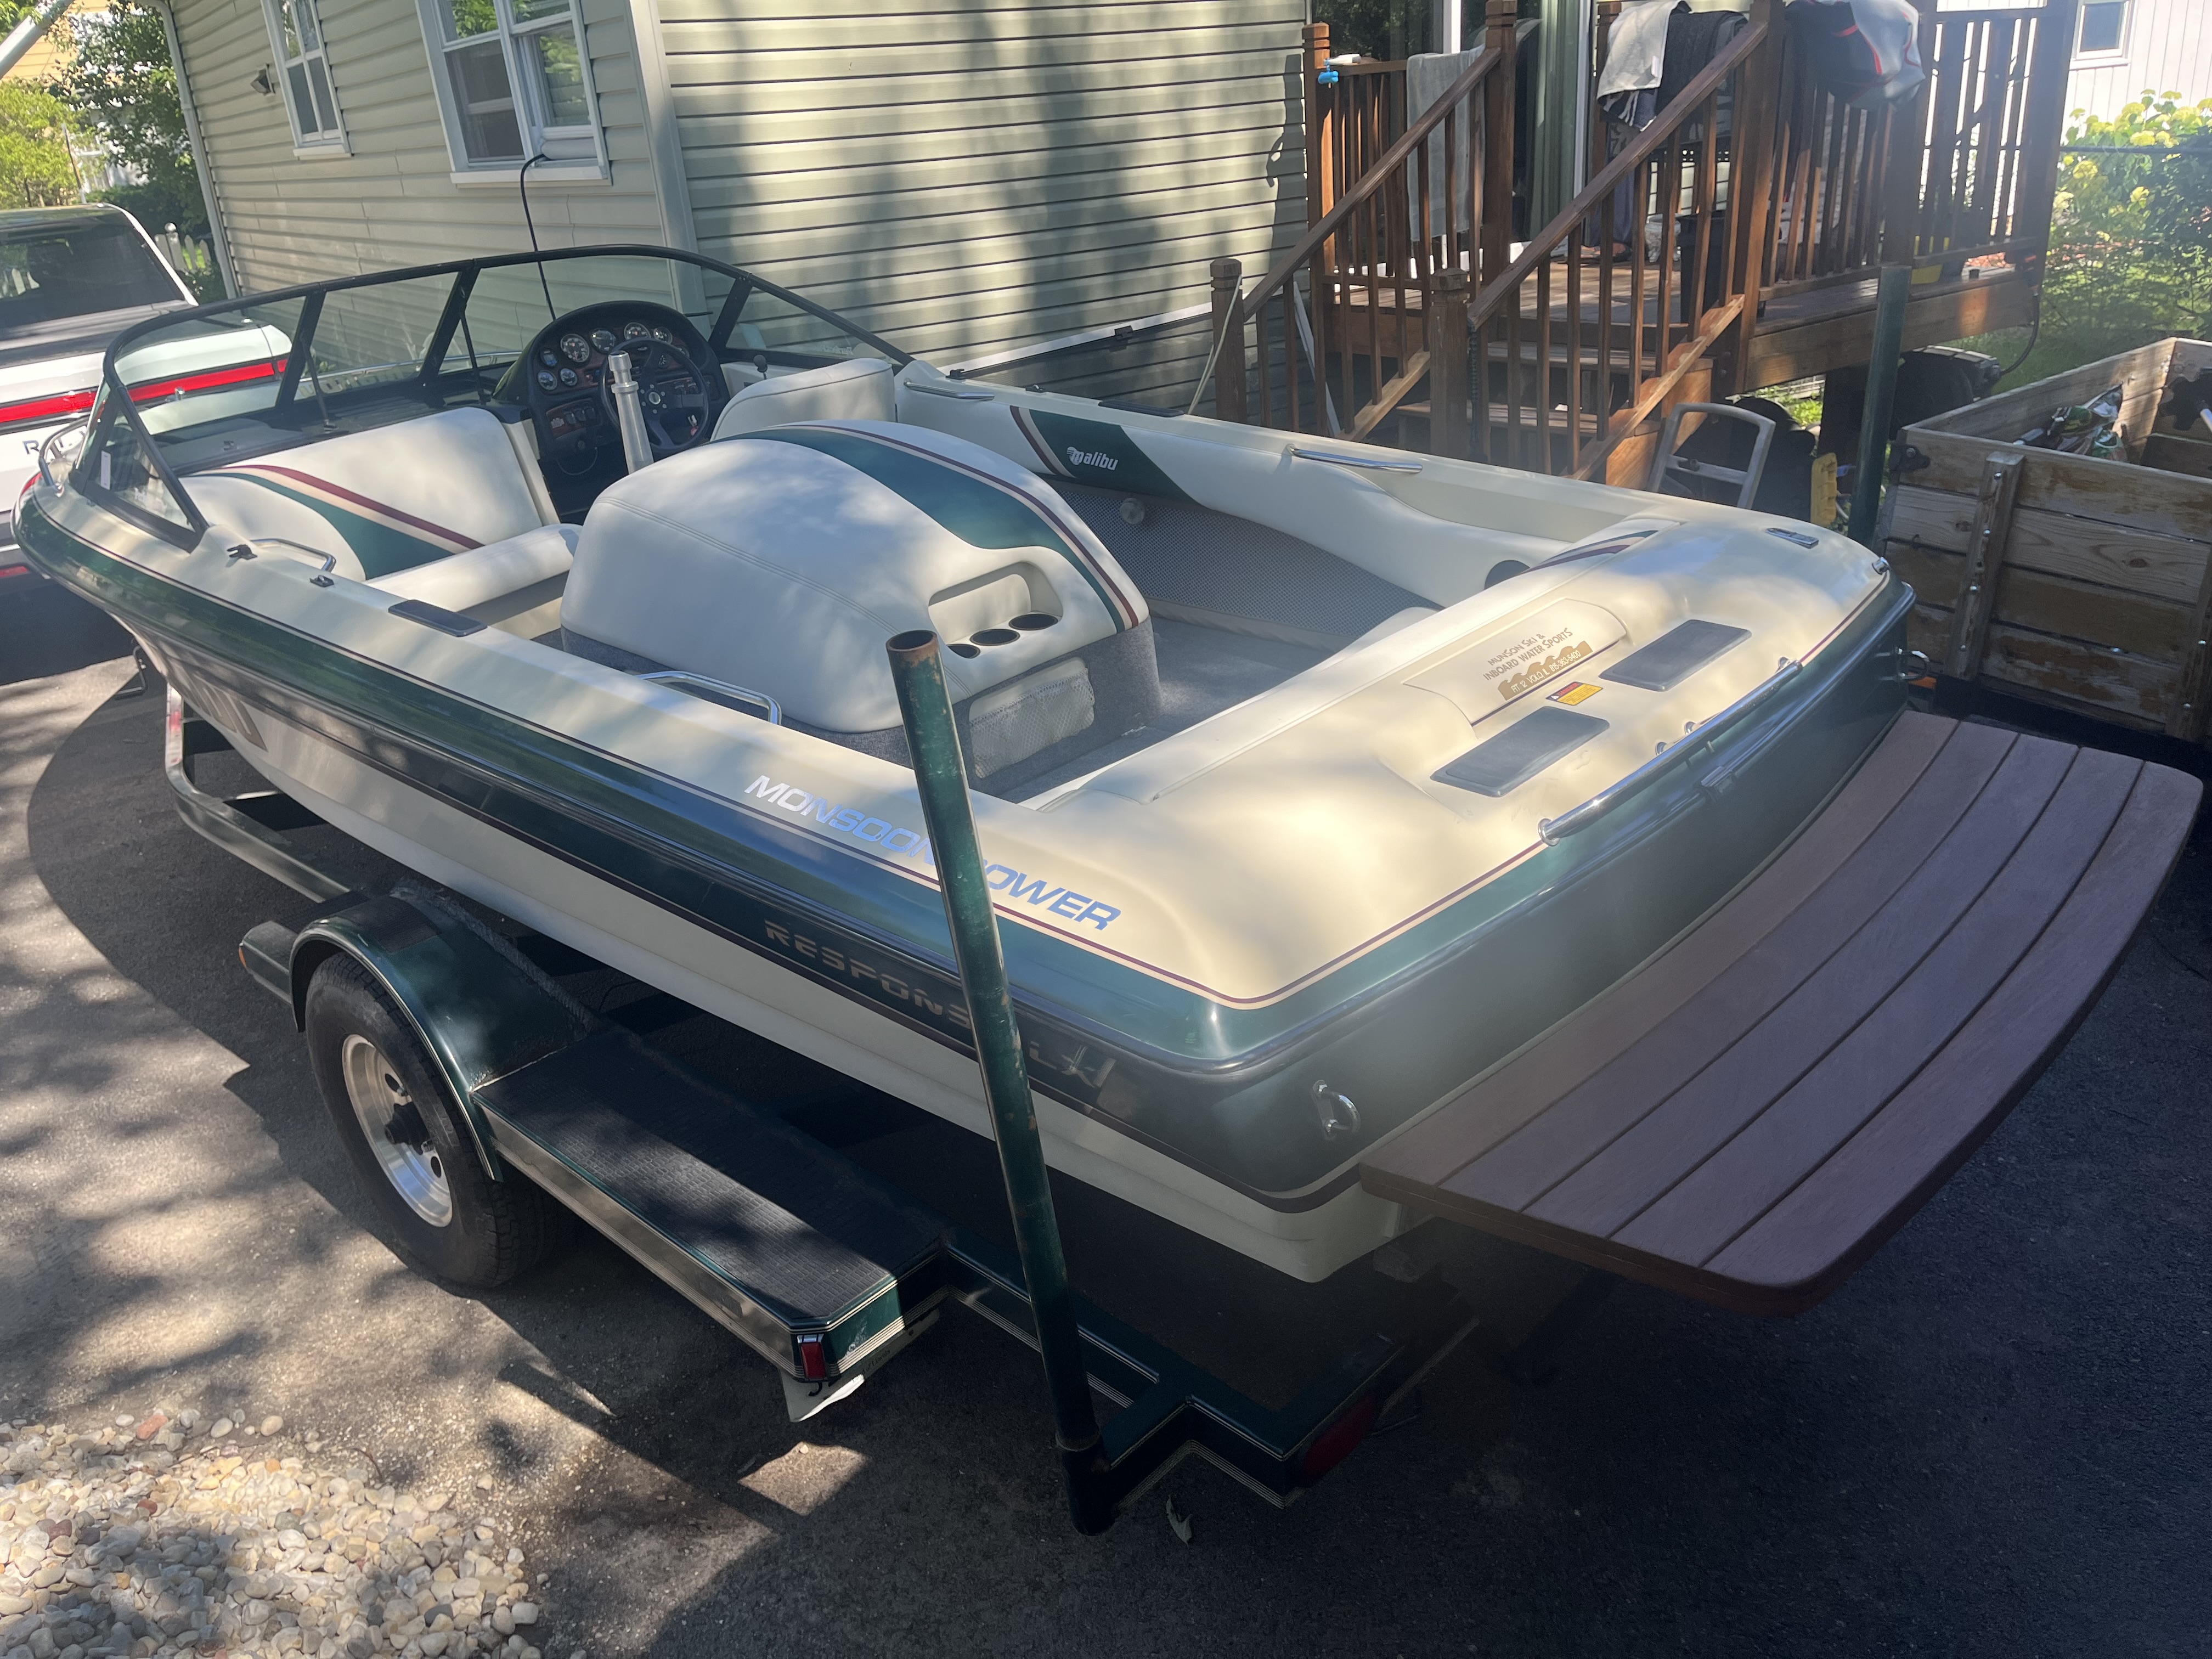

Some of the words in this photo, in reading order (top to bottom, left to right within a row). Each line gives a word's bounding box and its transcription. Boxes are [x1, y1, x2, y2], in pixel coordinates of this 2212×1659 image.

[1482, 659, 1519, 681] INBOARD
[1517, 645, 1546, 662] WATER
[1542, 627, 1573, 649] SPORTS
[1487, 644, 1525, 666] MUNSON
[1521, 637, 1538, 647] SKI
[1542, 668, 1550, 676] IL
[984, 859, 1122, 931] OWER
[764, 918, 972, 1030] RESPONS
